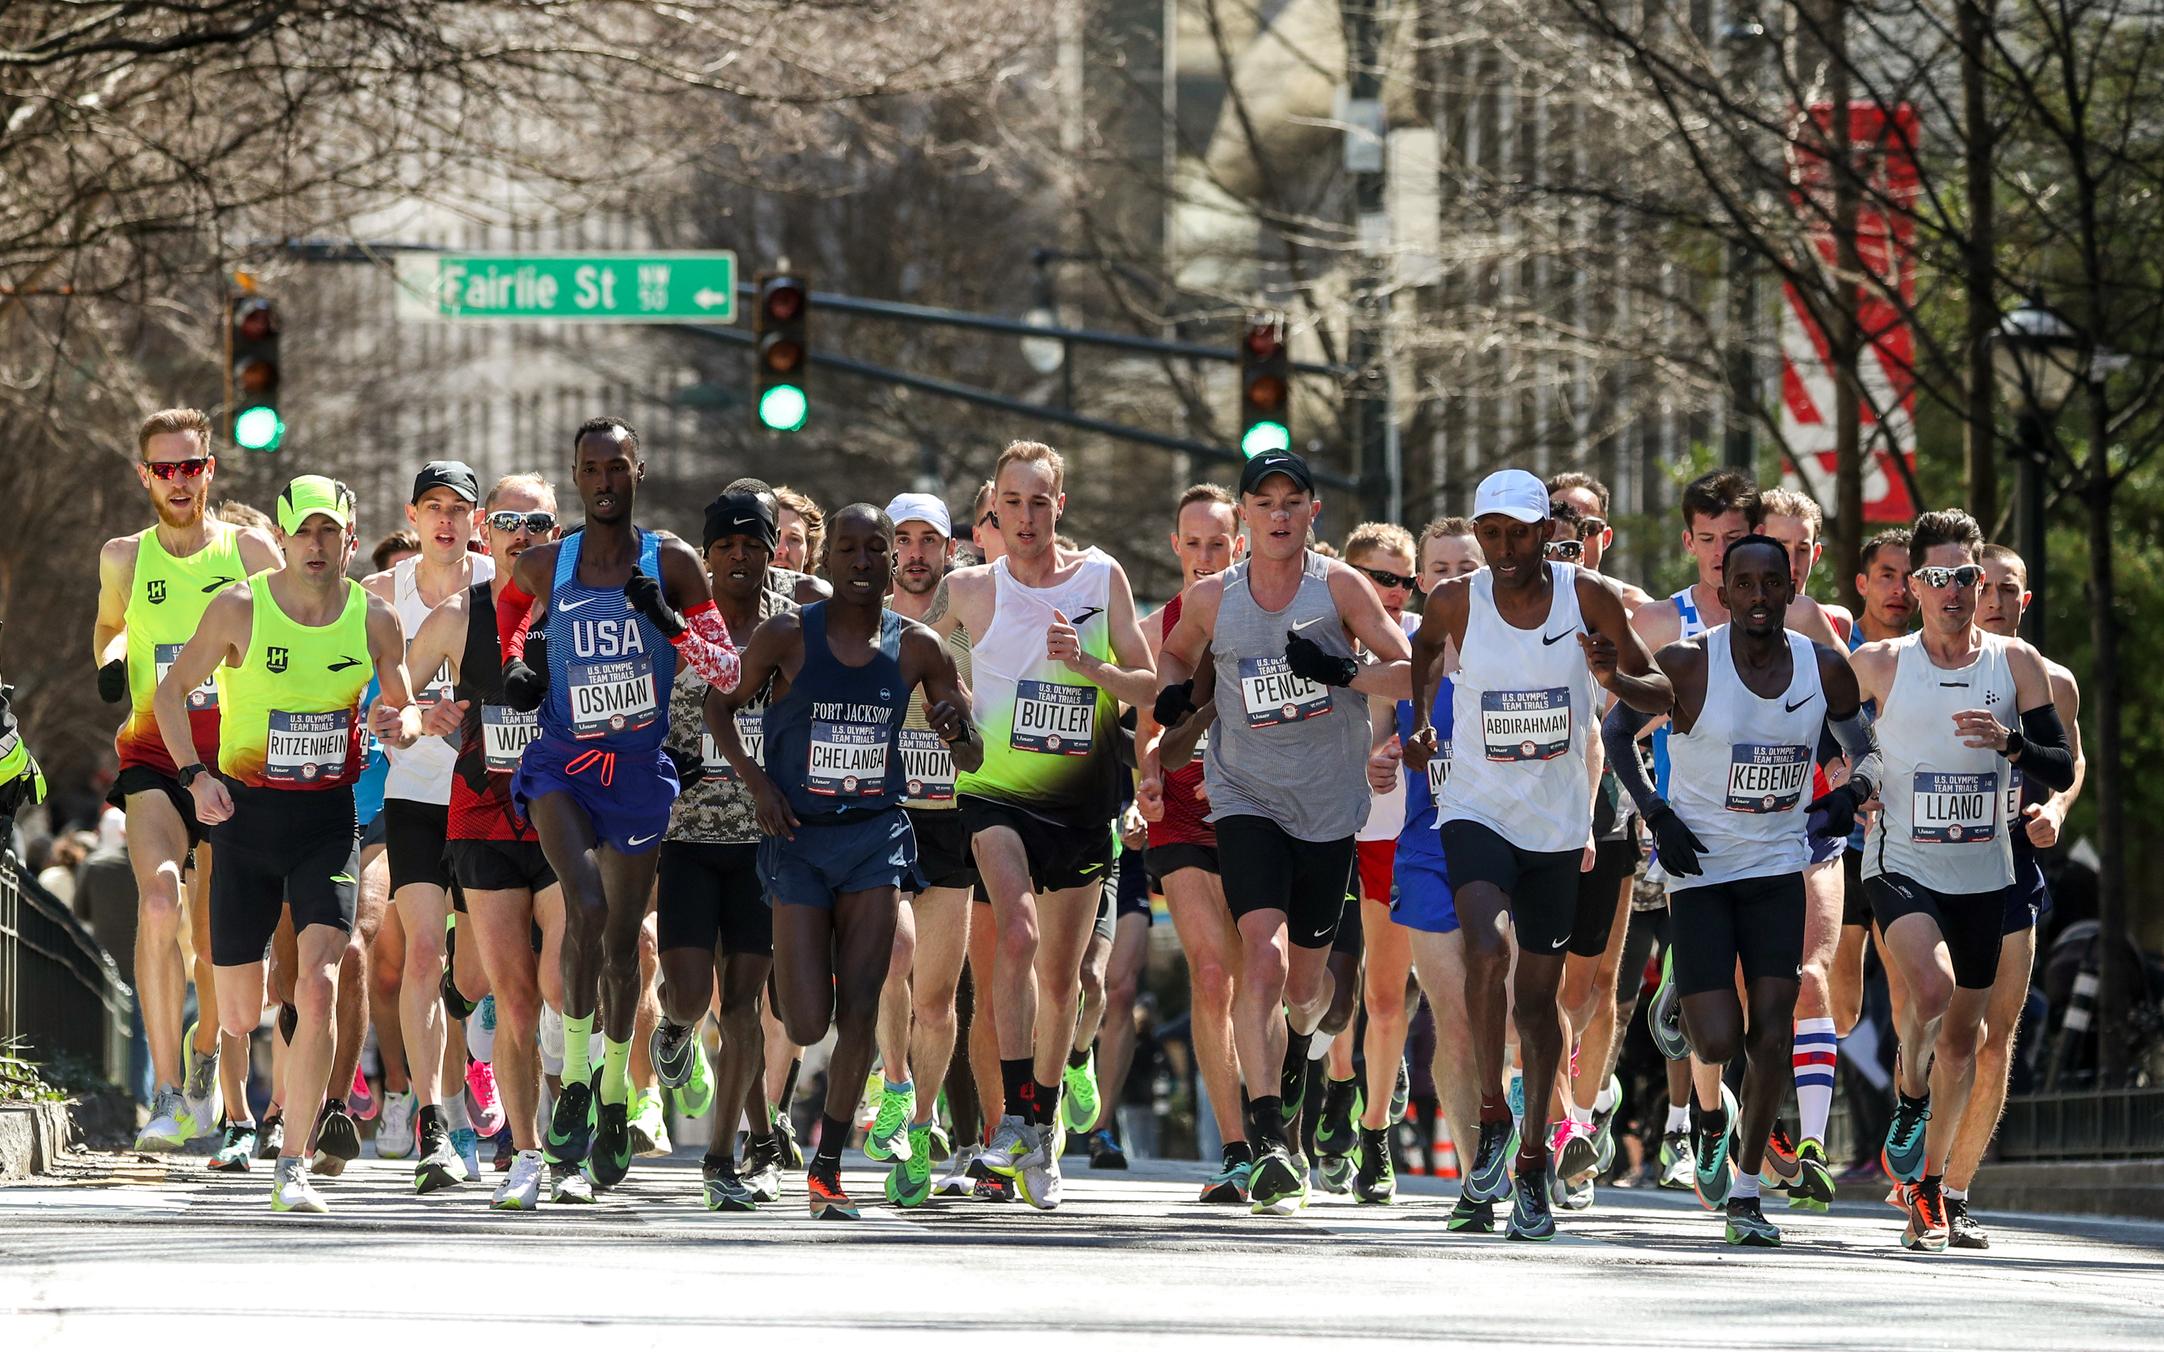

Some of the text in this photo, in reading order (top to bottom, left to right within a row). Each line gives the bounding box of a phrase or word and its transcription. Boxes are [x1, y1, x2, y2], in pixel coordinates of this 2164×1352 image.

[443, 264, 618, 310] Fairlie St
[572, 618, 644, 658] USA
[1256, 658, 1271, 667] U.S.
[586, 661, 634, 676] U.S. OLYMPIC
[1257, 665, 1277, 676] TEAM
[588, 670, 635, 685] TEAM TRIALS
[1038, 683, 1082, 696] U.S. OLYMPIC
[1253, 672, 1316, 704] PENCE
[578, 677, 648, 715] OSMAN
[1038, 692, 1057, 702] TEAM
[1058, 694, 1081, 704] TRIALS
[1501, 691, 1548, 702] U.S. OLYMPIC
[1502, 700, 1549, 711] TEAM TRIALS
[501, 707, 515, 716] U.S.
[812, 702, 893, 725] FORT JACKSON
[1021, 700, 1089, 733] BUTLER
[290, 714, 304, 723] U.S.
[305, 713, 335, 723] OLYMPIC
[501, 716, 521, 724] TEAM
[522, 714, 538, 724] TRIA
[737, 717, 762, 726] OLYMPI
[290, 722, 334, 732] TEAM TRIALS
[1486, 713, 1567, 735] ABDIRAHMAN
[742, 726, 763, 734] TRIAL
[831, 725, 847, 734] U.S.
[847, 726, 875, 735] OLYMPIC
[831, 734, 852, 743] TEAM
[852, 734, 875, 744] TRIALS
[910, 731, 940, 741] OLYMPIC
[270, 734, 347, 756] RITZENHEIN
[899, 740, 940, 750] EAM TRIALS
[1754, 746, 1796, 756] U.S. OLYMPIC
[812, 745, 885, 770] CHELANGA
[1753, 755, 1795, 764] TEAM TRIALS
[1733, 763, 1805, 791] KEBENEI
[1934, 775, 1949, 784] U.S.
[1949, 775, 1979, 785] OLYMPIC
[1934, 784, 1953, 793] TEAM
[1955, 784, 1978, 793] TRIALS
[1926, 794, 1984, 821] LLANO
